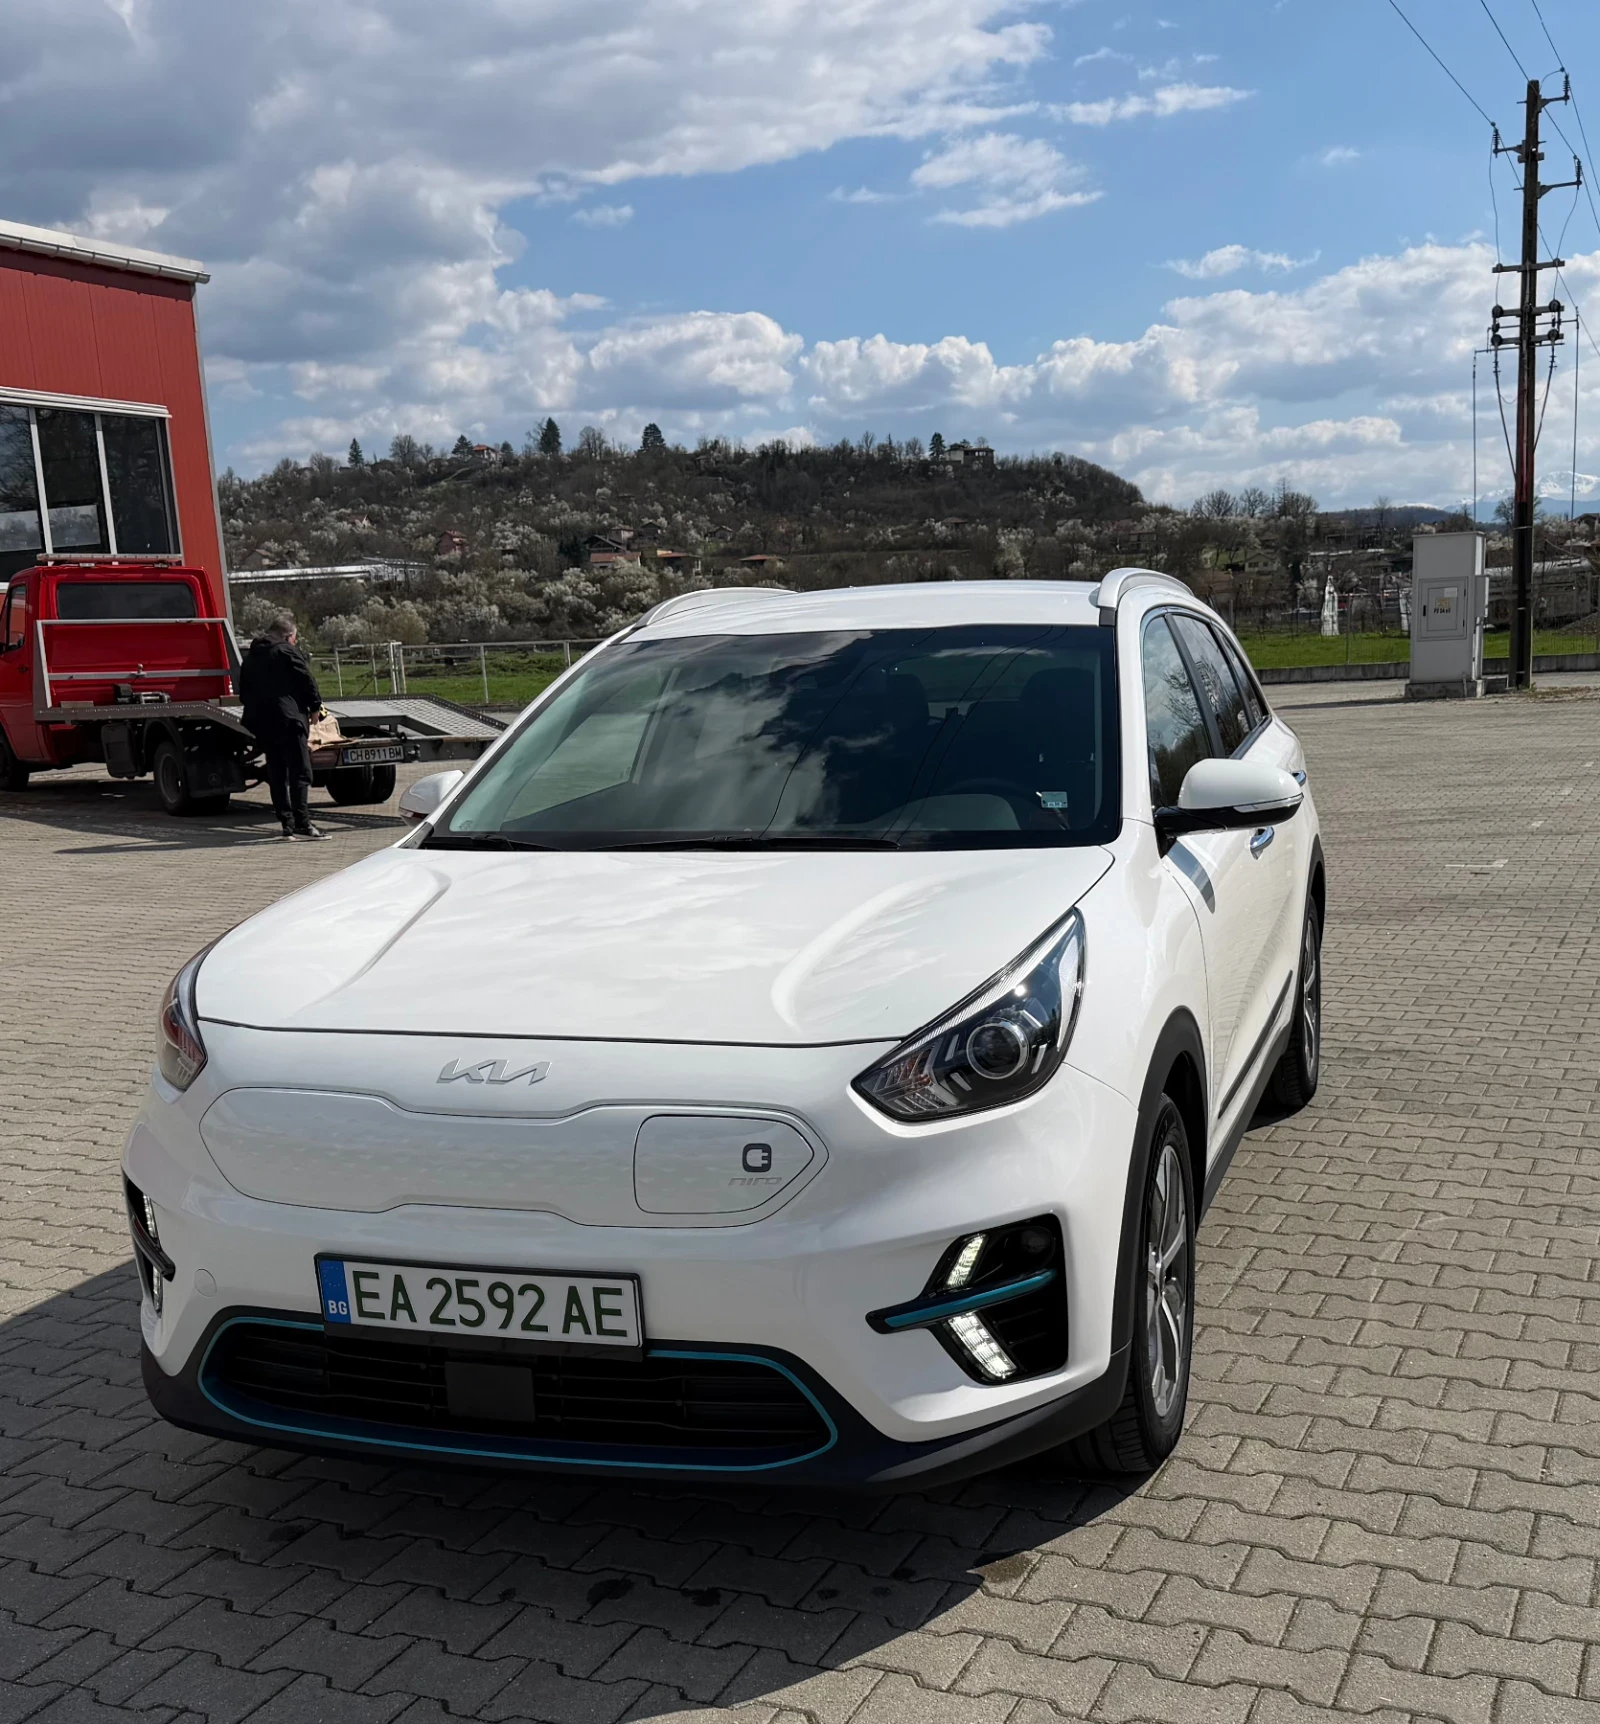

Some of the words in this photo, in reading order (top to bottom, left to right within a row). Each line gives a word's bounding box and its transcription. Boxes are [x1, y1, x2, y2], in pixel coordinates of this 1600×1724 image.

[350, 750, 363, 761] CH
[365, 749, 387, 760] 8911
[389, 747, 402, 758] BM
[436, 1058, 552, 1086] KIA
[329, 1301, 348, 1315] BG
[352, 1270, 417, 1323] EA
[426, 1277, 549, 1332] 2592
[562, 1285, 628, 1337] AE
